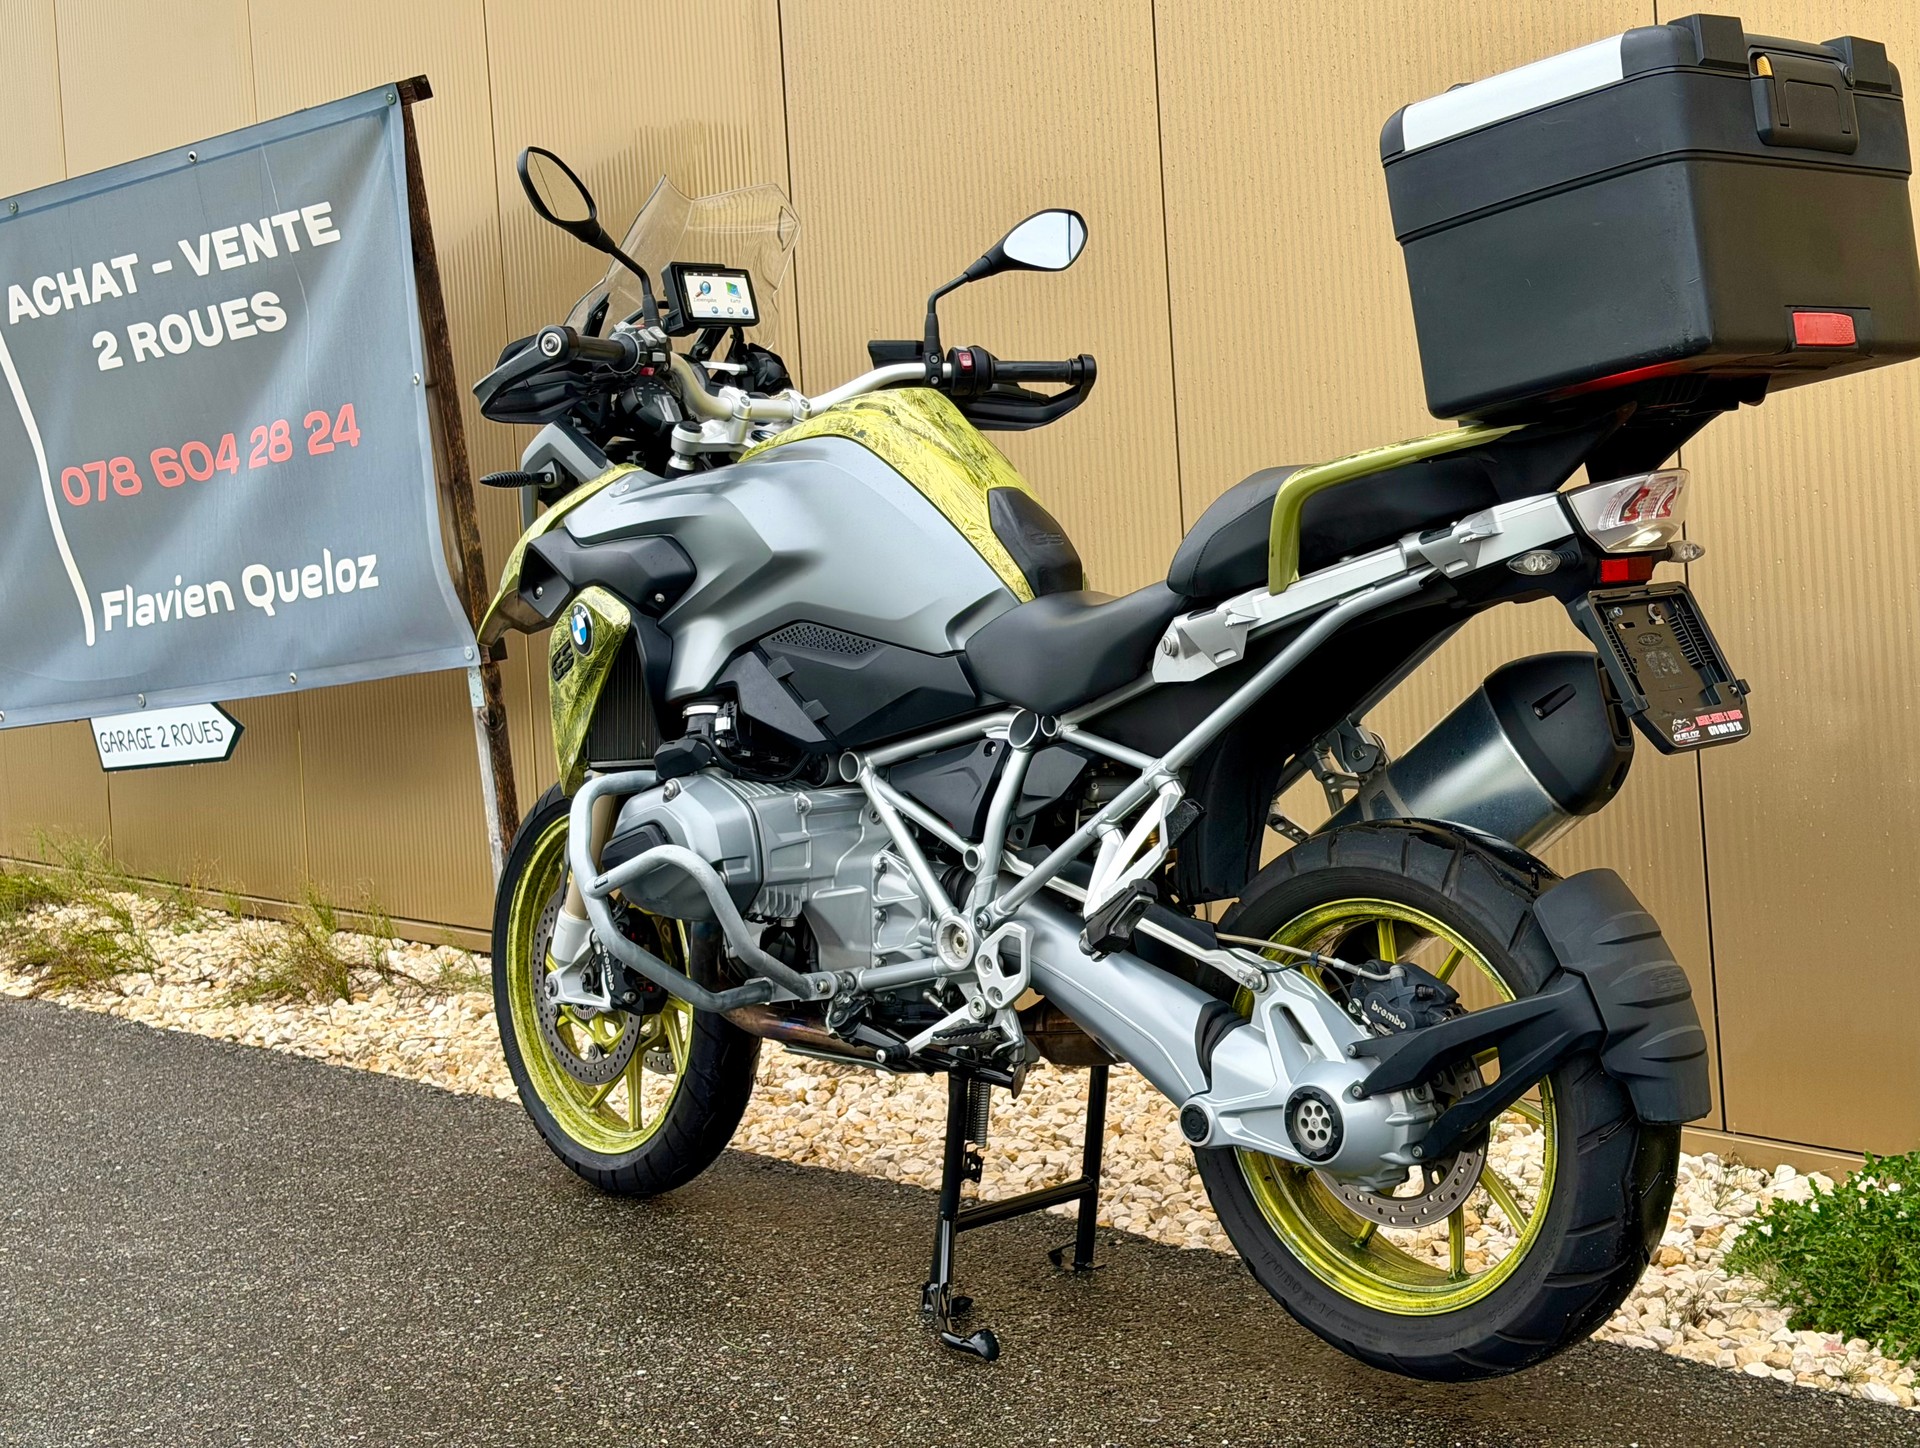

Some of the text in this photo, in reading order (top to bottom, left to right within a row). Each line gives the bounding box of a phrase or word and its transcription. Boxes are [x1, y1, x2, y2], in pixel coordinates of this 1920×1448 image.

[8, 201, 341, 324] ACHAT - VENTE
[92, 291, 287, 371] 2 ROUES
[60, 403, 360, 507] 078 604 28 24
[101, 548, 379, 631] Flavien Queloz
[552, 640, 574, 682] GS
[99, 719, 224, 754] GARAGE 2 ROUES
[1371, 1000, 1407, 1030] brembo
